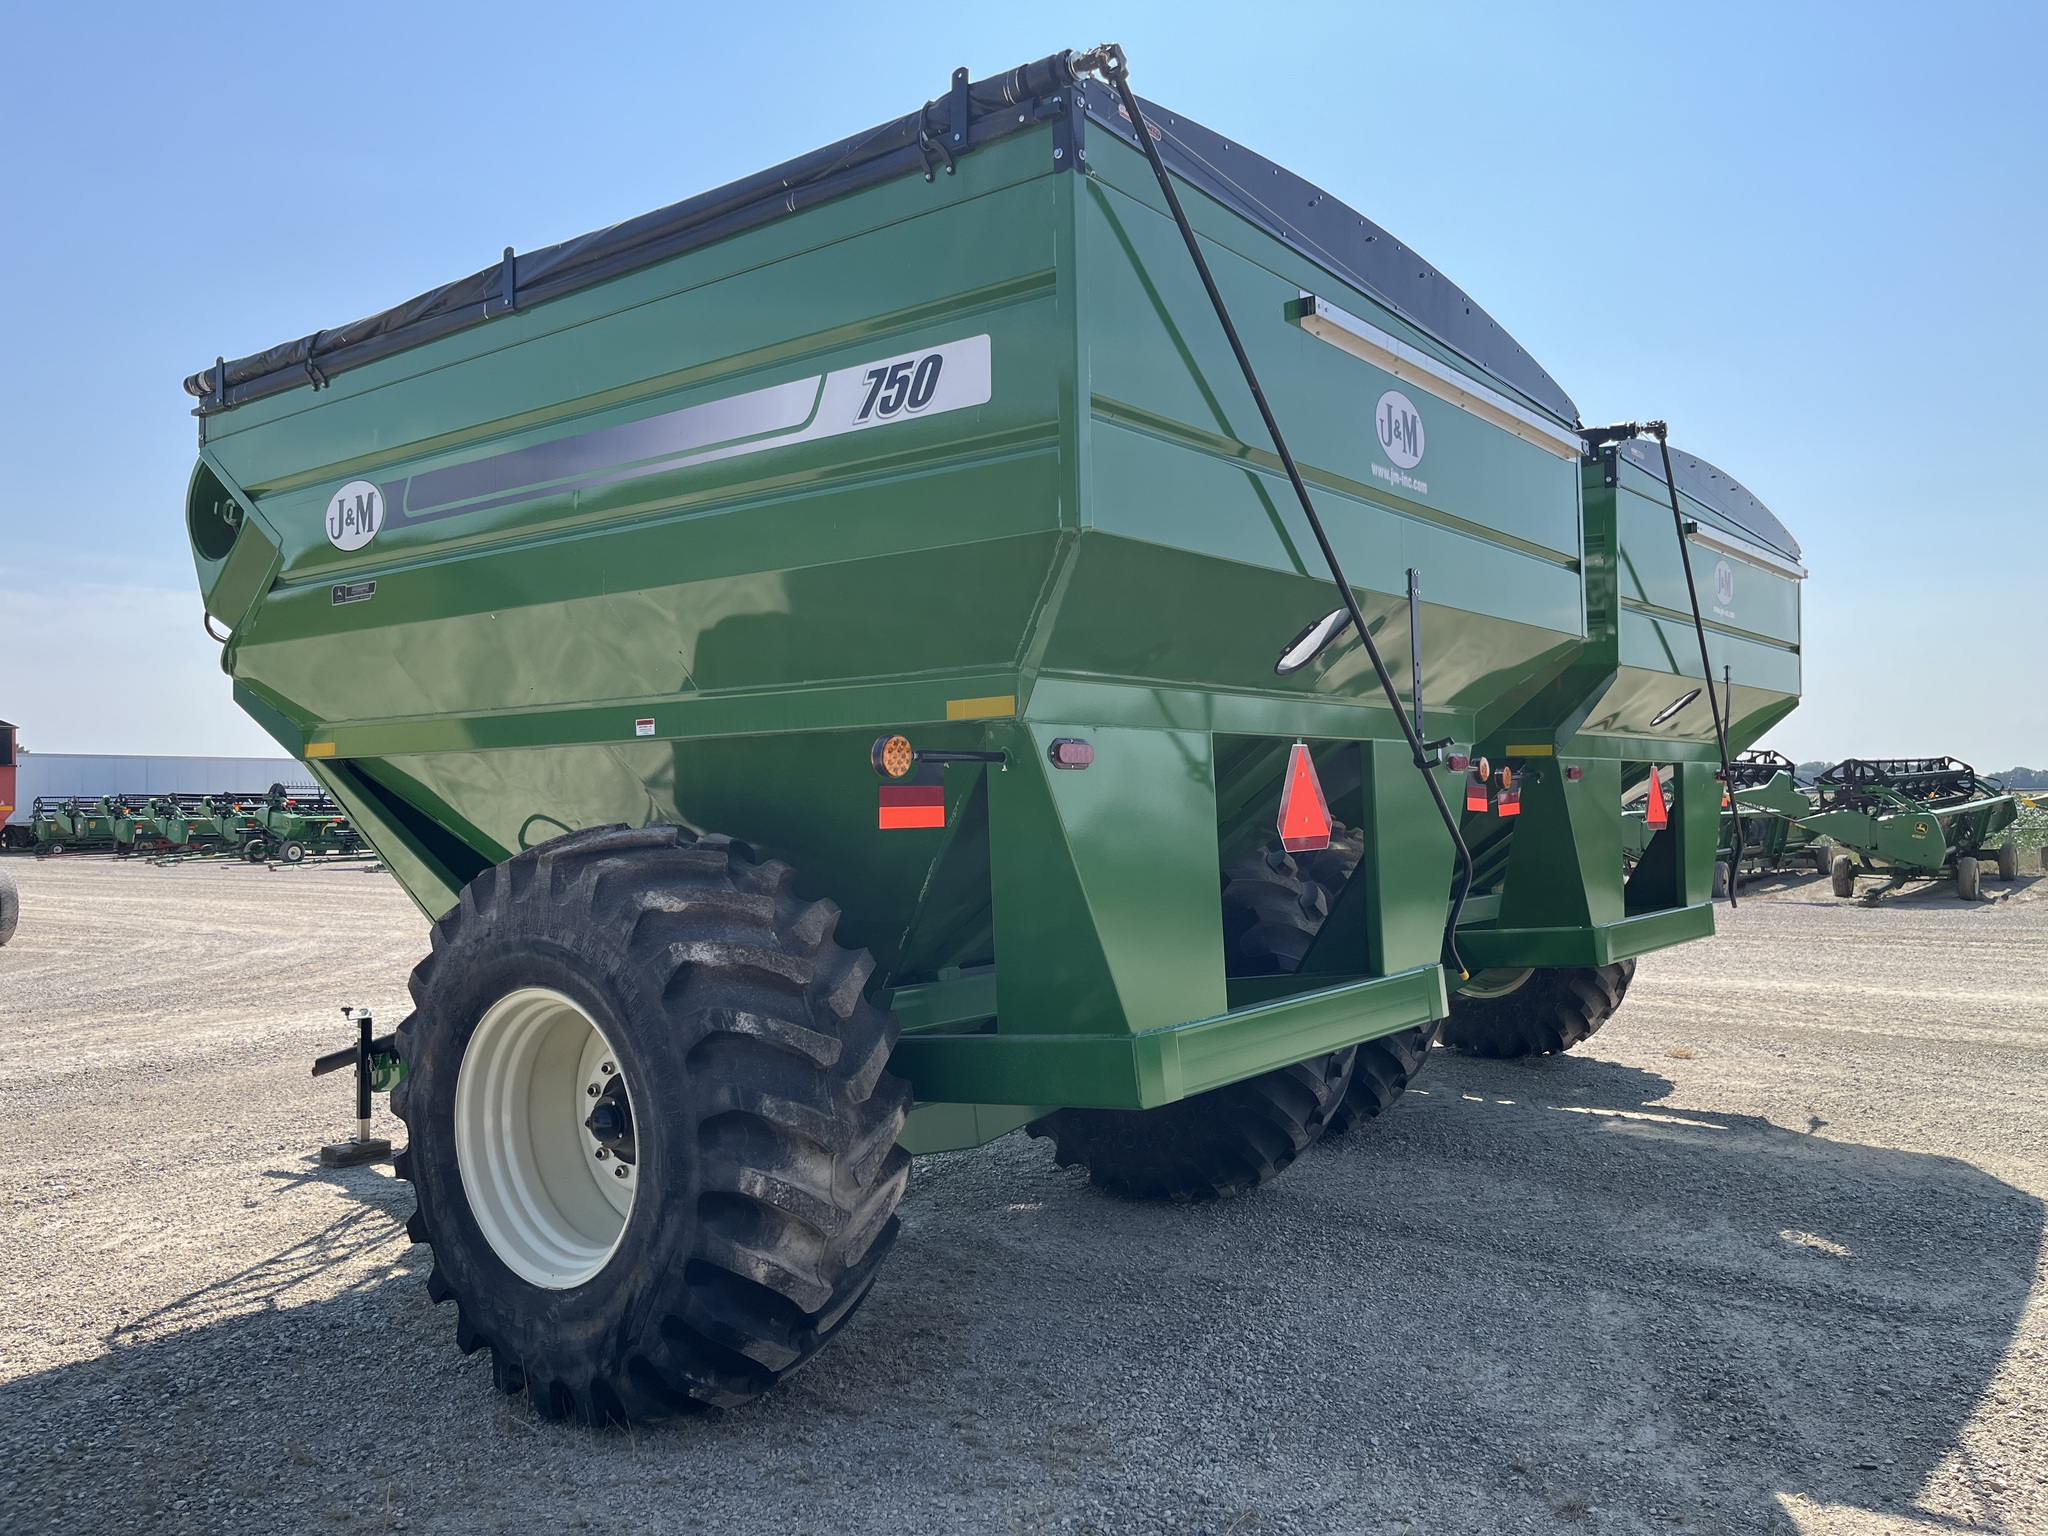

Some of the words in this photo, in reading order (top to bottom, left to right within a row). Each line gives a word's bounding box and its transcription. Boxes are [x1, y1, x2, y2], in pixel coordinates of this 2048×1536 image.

[854, 353, 944, 424] 750
[1379, 403, 1419, 458] J&M
[1371, 462, 1428, 495] www.jm-inc.com
[329, 491, 375, 540] J&M
